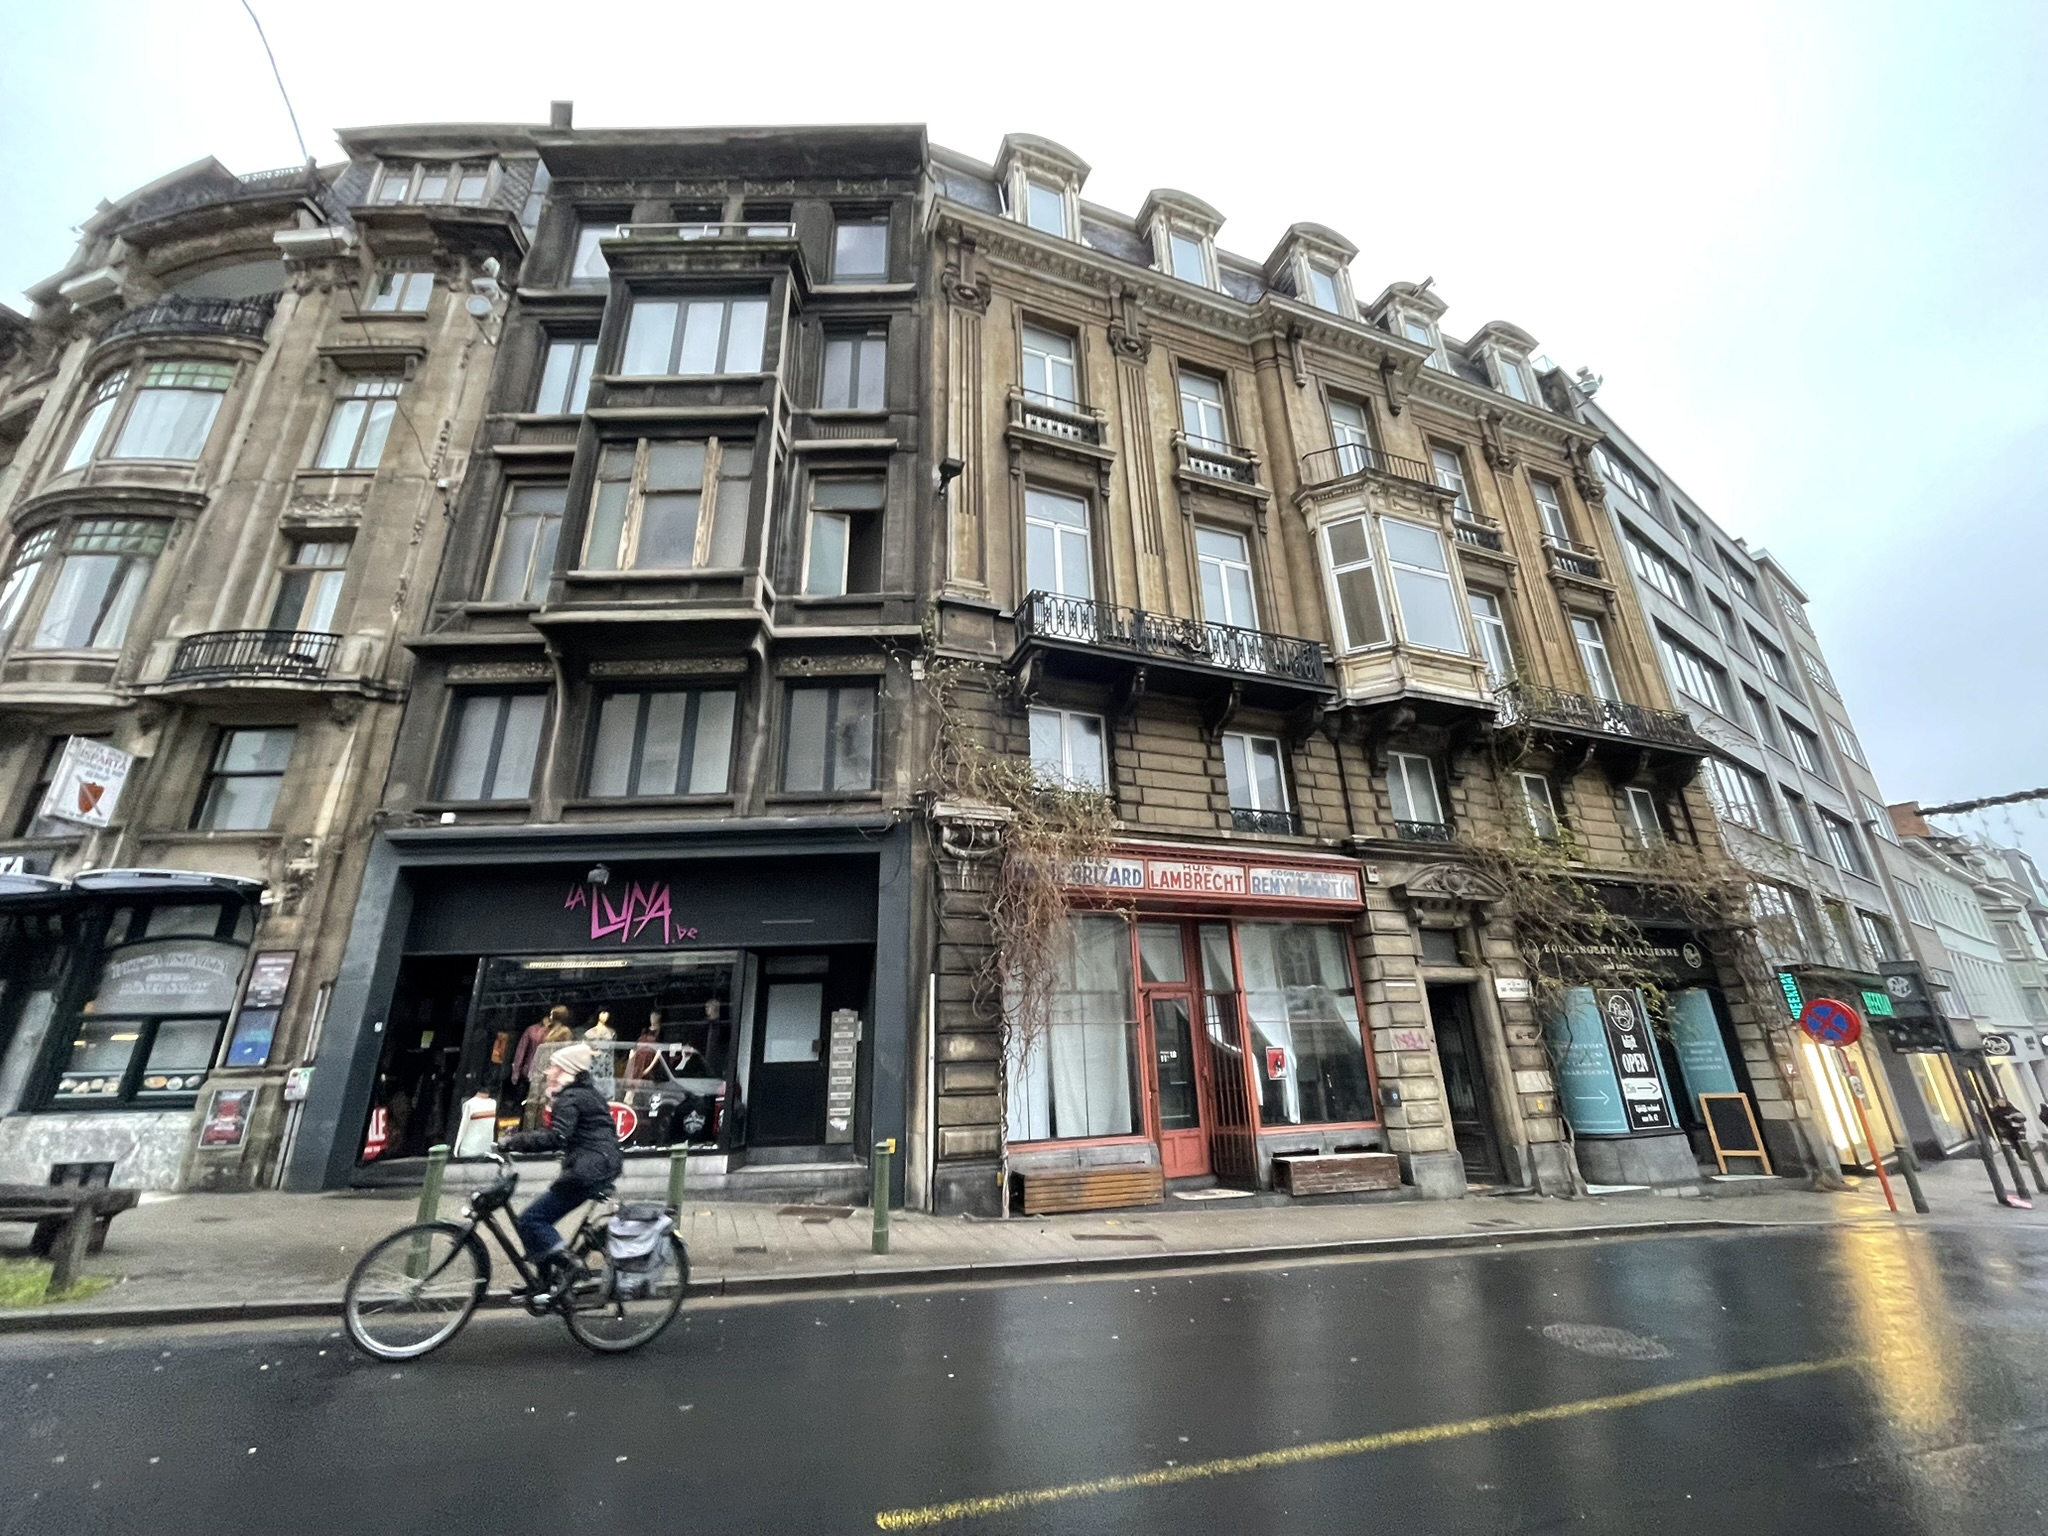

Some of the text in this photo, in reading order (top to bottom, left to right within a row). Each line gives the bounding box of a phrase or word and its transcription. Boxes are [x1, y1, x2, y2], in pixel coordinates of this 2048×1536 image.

[1150, 869, 1243, 892] LAMBRECHT
[1252, 875, 1291, 894] REMY
[1270, 869, 1306, 879] COGNAC
[563, 882, 587, 911] LA
[591, 880, 672, 945] LUNA
[1778, 972, 1803, 1020] WEEKDAY
[1622, 1053, 1649, 1073] OPEN
